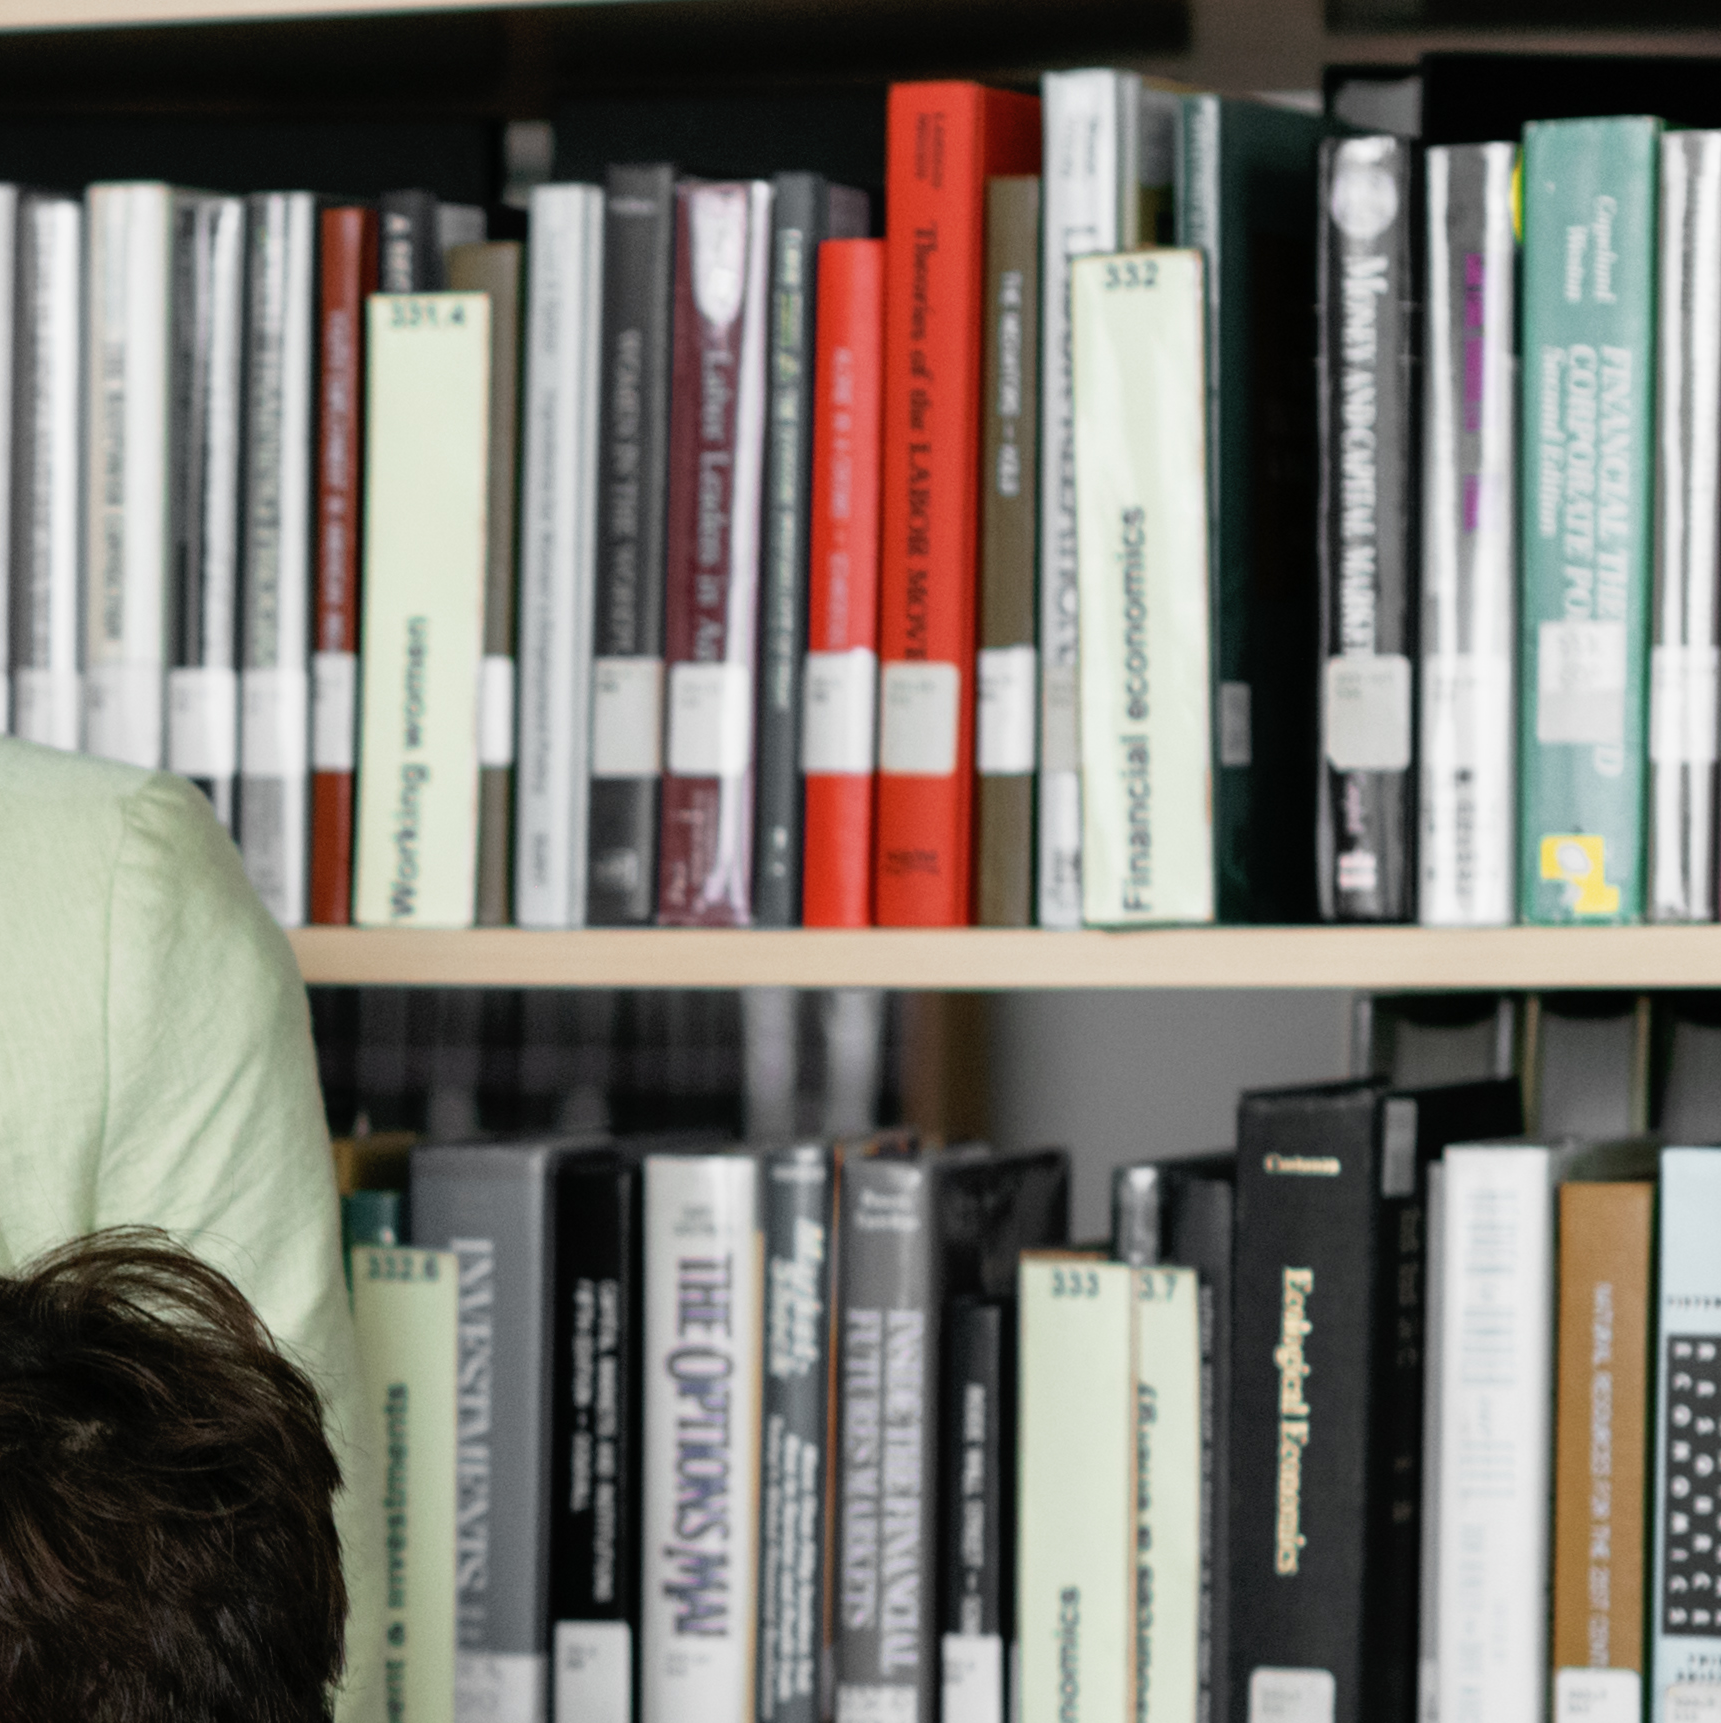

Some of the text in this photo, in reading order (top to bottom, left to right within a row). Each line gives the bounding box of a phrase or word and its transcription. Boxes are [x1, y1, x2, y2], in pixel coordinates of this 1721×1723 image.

[906, 227, 936, 554] Theories the LABOR
[1103, 259, 1160, 291] 332
[1345, 255, 1385, 362] MONEY
[1563, 344, 1597, 555] CORPORATE
[1597, 345, 1634, 540] FINANCIAL
[389, 616, 429, 917] Working women
[1119, 507, 1151, 911] Financial economics
[456, 1238, 493, 1593] INVESTMENTS
[666, 1250, 734, 1541] THE OPTIONS
[1052, 1269, 1101, 1299] 333
[1272, 1266, 1315, 1576] Ecological Economics
